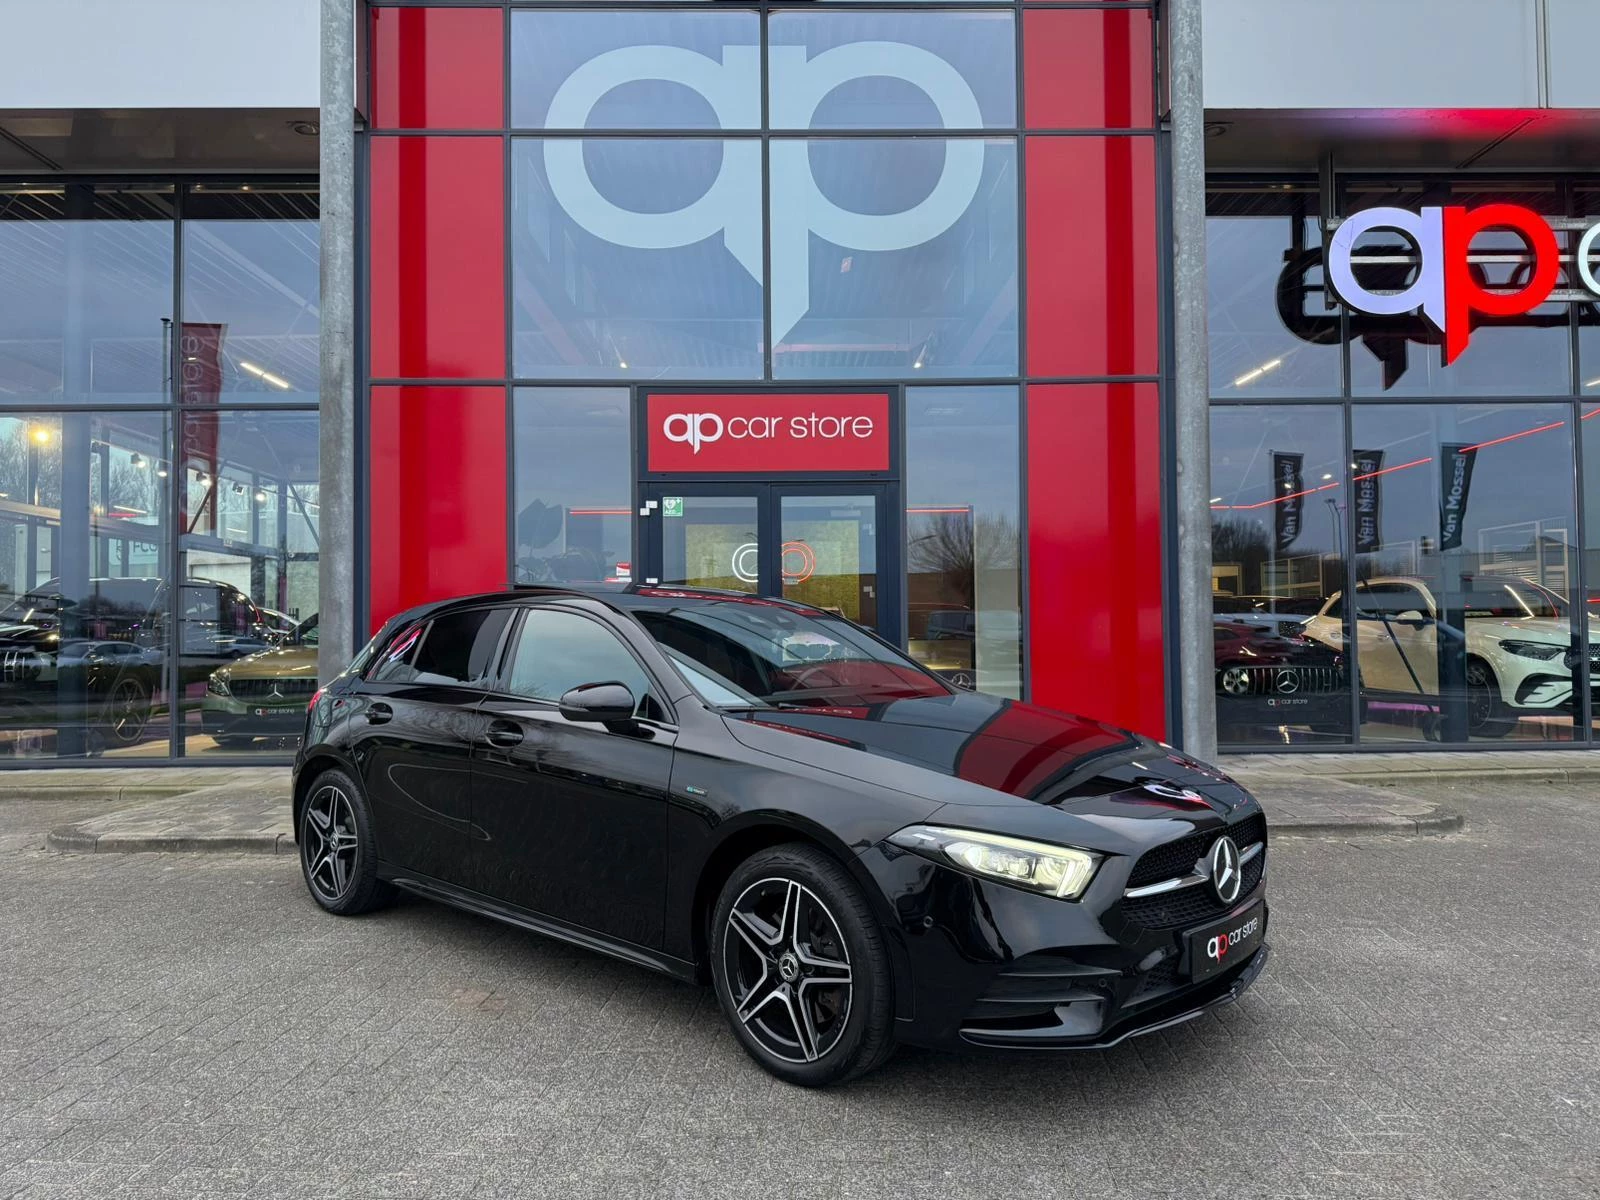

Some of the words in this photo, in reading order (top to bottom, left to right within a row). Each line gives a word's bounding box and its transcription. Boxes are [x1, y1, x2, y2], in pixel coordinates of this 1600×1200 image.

[543, 41, 985, 350] ap
[1328, 203, 1560, 366] ap
[663, 412, 724, 455] ap
[727, 416, 783, 439] car
[789, 411, 874, 439] store
[1446, 454, 1468, 510] Mossel
[1280, 516, 1297, 543] Van
[1357, 516, 1374, 545] Van
[1443, 514, 1457, 542] Van
[1207, 934, 1228, 964] ap
[1228, 928, 1242, 946] car
[1242, 917, 1258, 938] store
